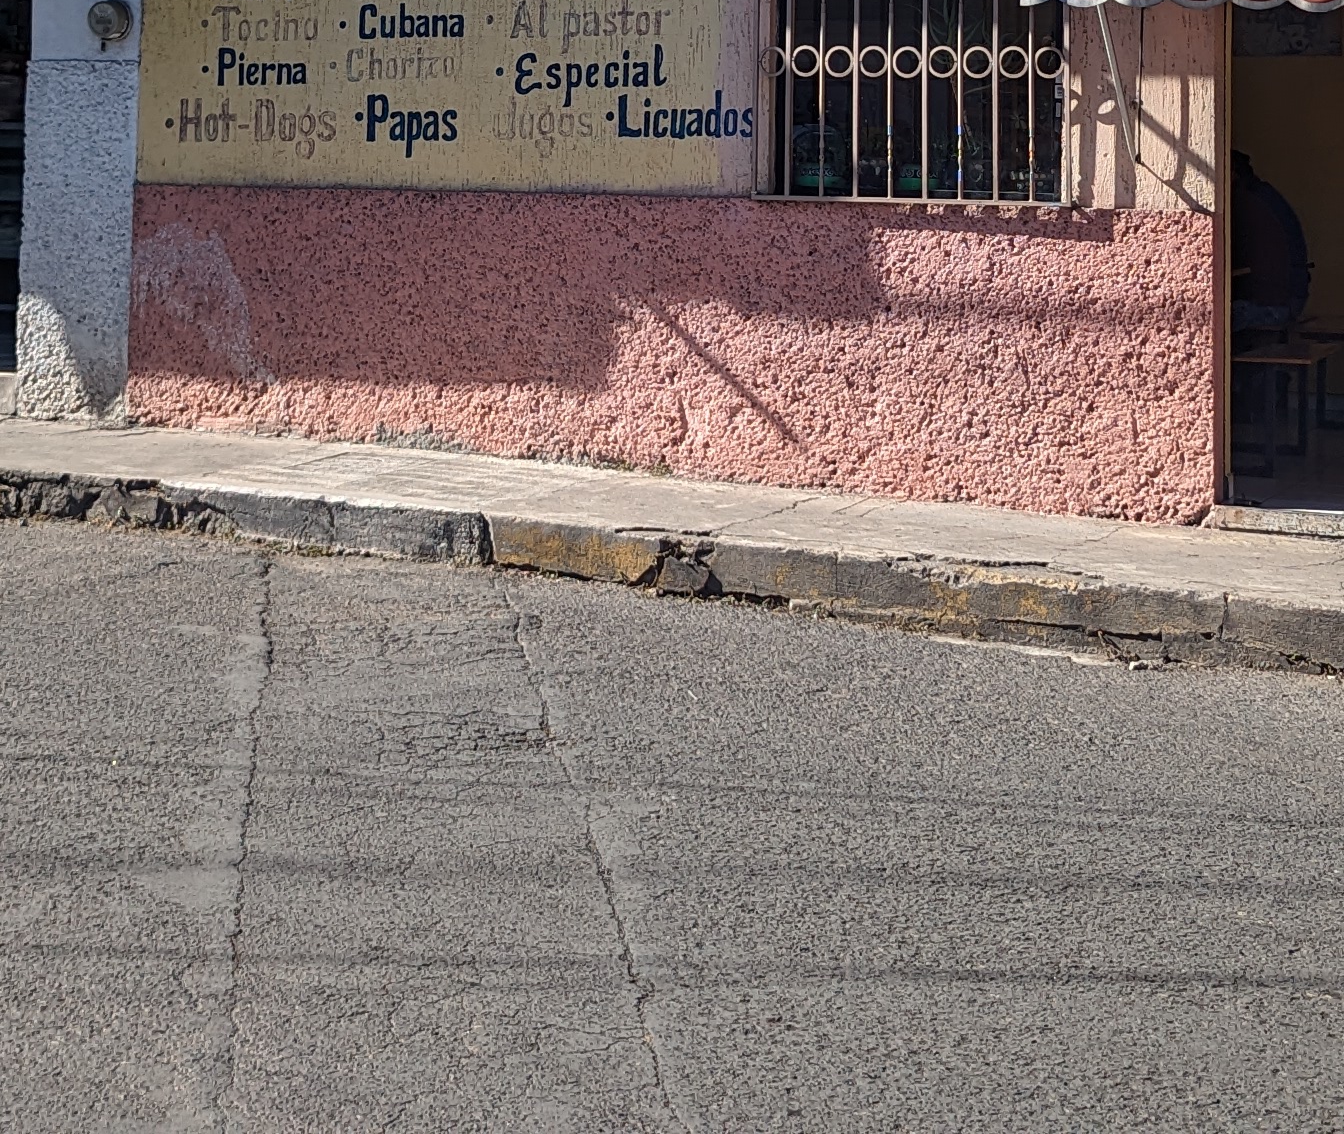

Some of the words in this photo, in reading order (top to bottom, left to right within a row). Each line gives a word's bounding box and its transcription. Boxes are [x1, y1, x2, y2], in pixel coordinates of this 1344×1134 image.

[212, 6, 319, 42] Tocino
[358, 3, 465, 39] Cubana
[217, 47, 307, 86] Pierna
[346, 47, 457, 82] Chorizo
[514, 43, 668, 107] Especial
[178, 97, 337, 159] Hot-Dogs
[366, 93, 458, 158] Papas
[617, 90, 753, 140] Licuados
